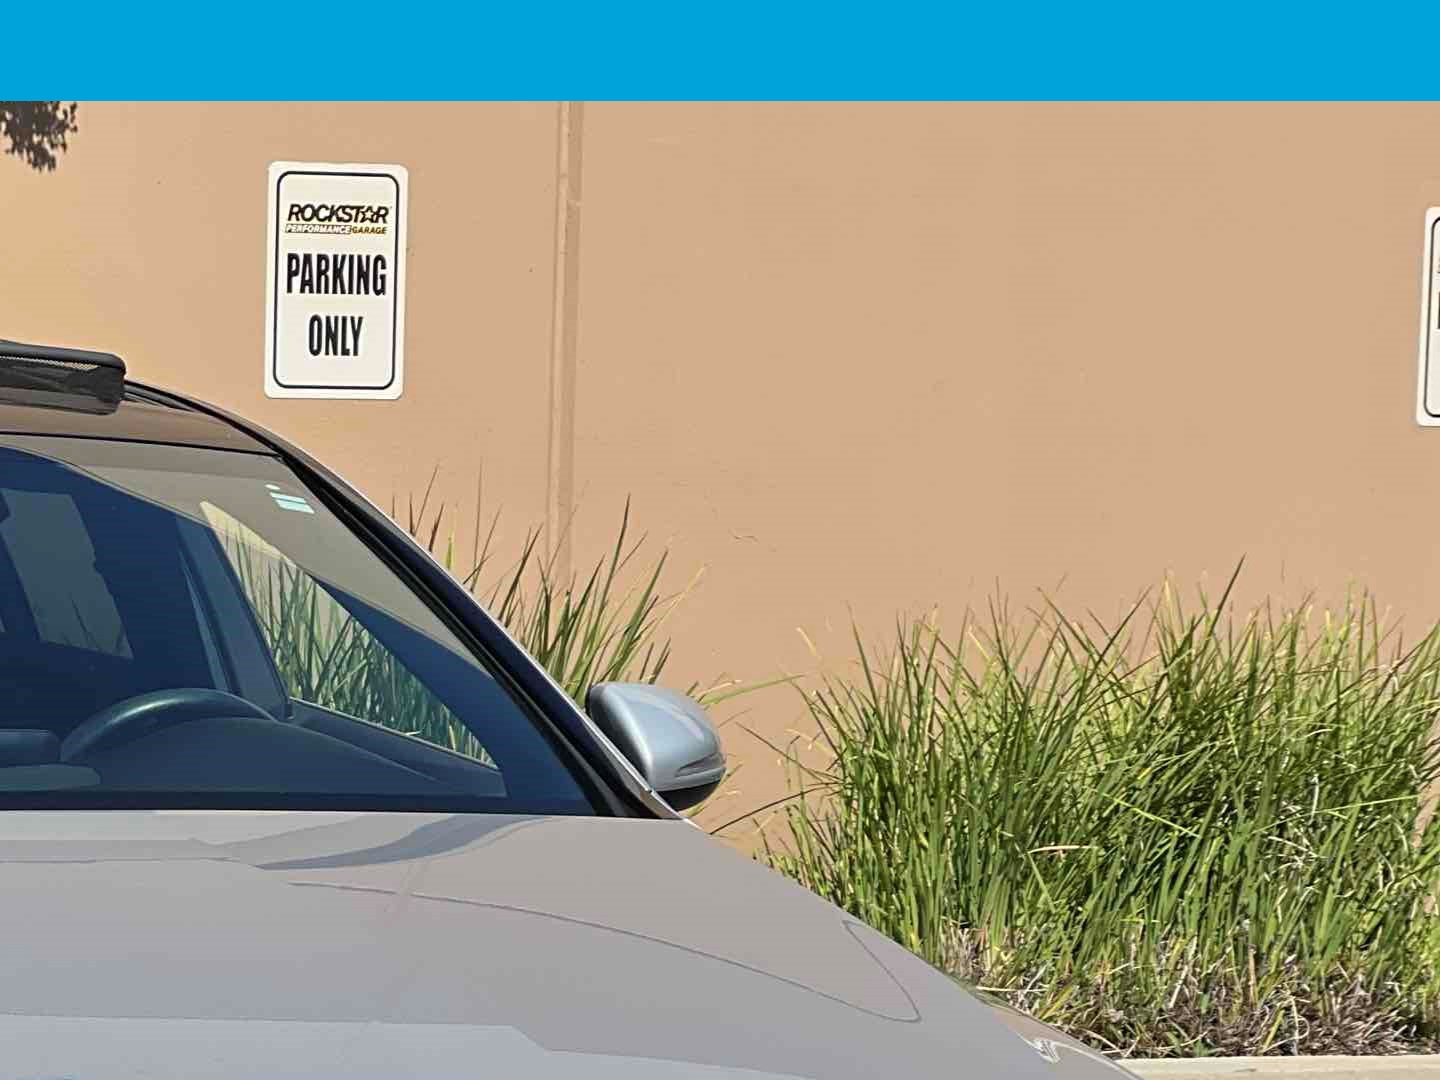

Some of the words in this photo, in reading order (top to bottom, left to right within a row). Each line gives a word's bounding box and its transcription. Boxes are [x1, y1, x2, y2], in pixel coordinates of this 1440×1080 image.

[285, 224, 352, 235] PERFORMANCE
[352, 226, 387, 236] GARAGE
[286, 252, 388, 297] PARKING
[308, 314, 364, 357] ONLY
